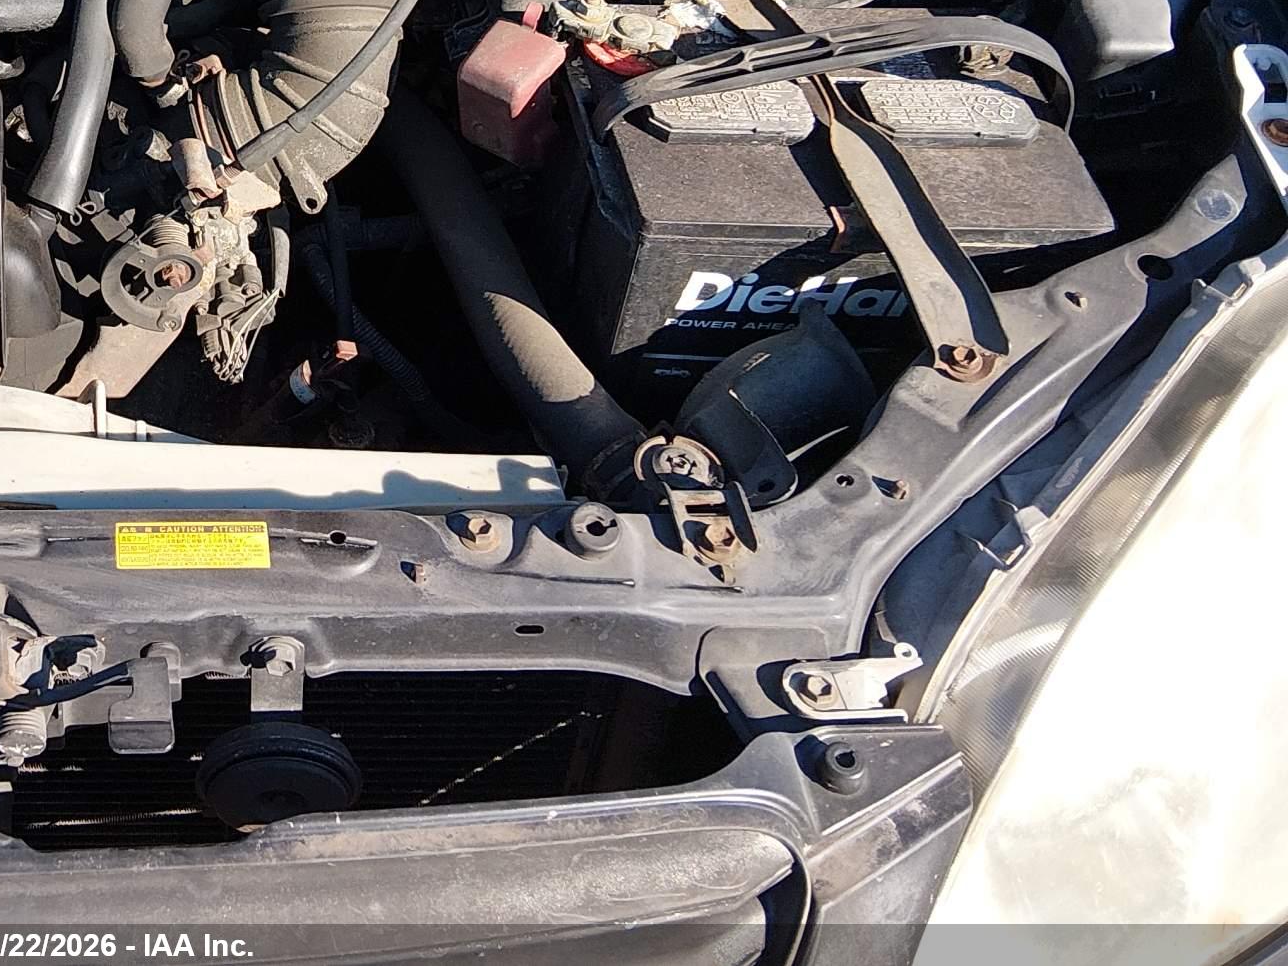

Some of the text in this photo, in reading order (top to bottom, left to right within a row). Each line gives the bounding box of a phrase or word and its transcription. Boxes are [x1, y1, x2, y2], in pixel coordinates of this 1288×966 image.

[675, 271, 909, 317] DieHar
[665, 318, 737, 330] POWER
[159, 525, 205, 533] CAUTION
[212, 525, 262, 533] ATTENTION
